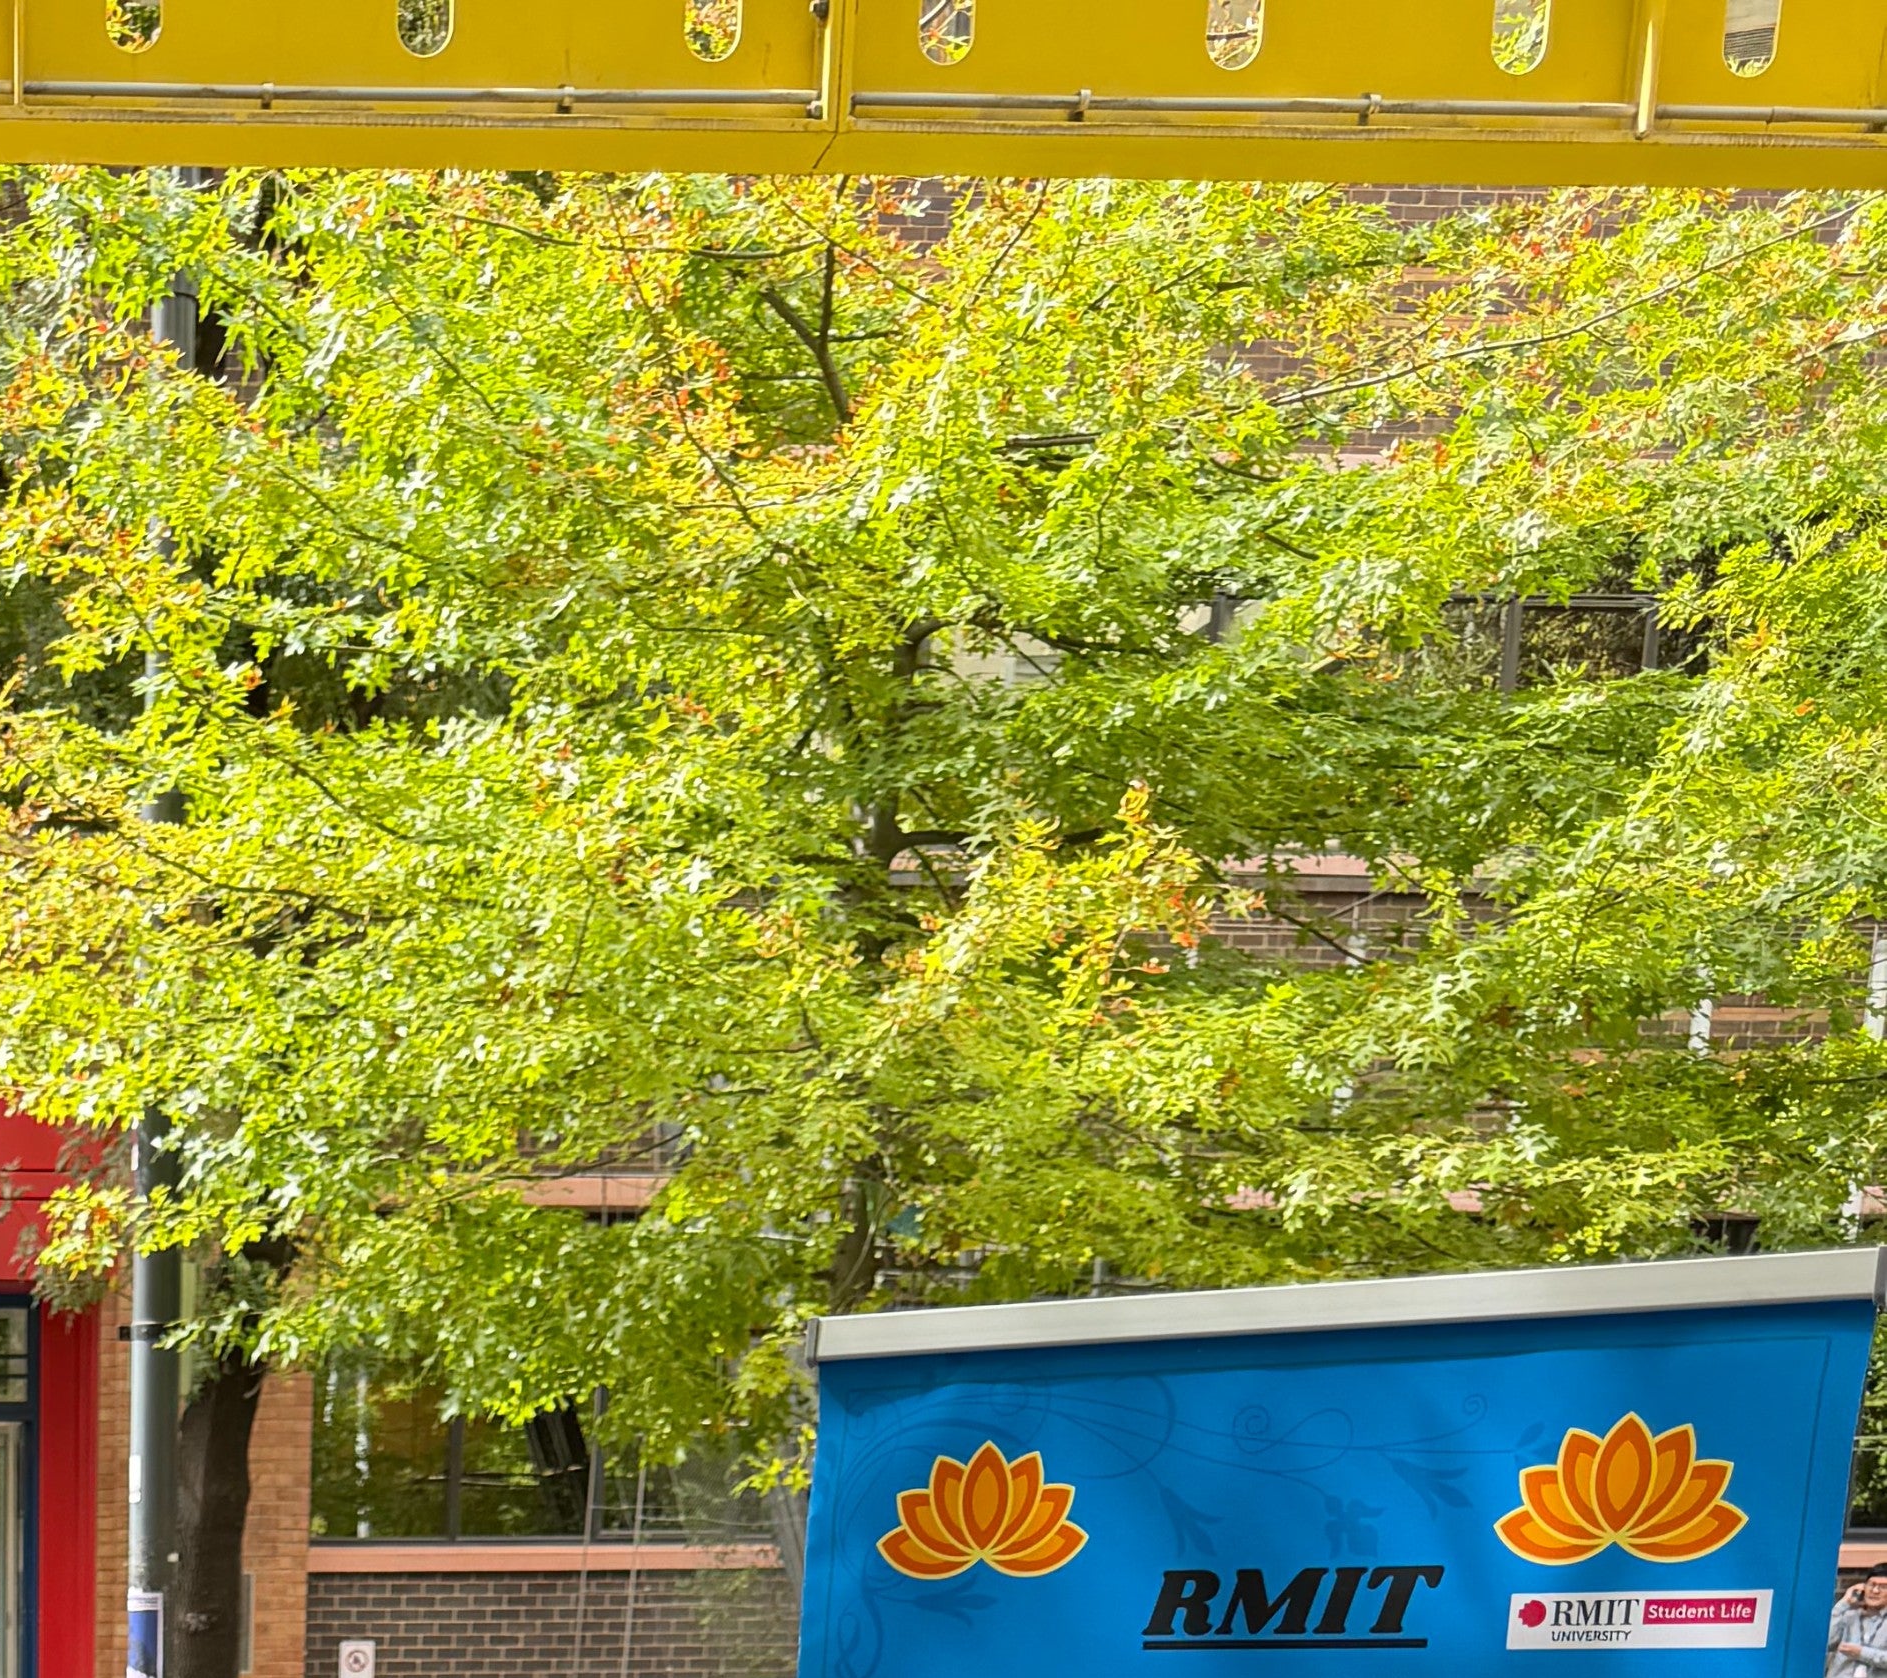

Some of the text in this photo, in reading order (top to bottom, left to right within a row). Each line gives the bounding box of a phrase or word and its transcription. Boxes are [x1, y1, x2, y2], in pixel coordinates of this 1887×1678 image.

[1141, 1565, 1445, 1636] RMIT
[1550, 1599, 1753, 1626] RMIT Student Life
[1551, 1630, 1632, 1642] UNIVERSITY
